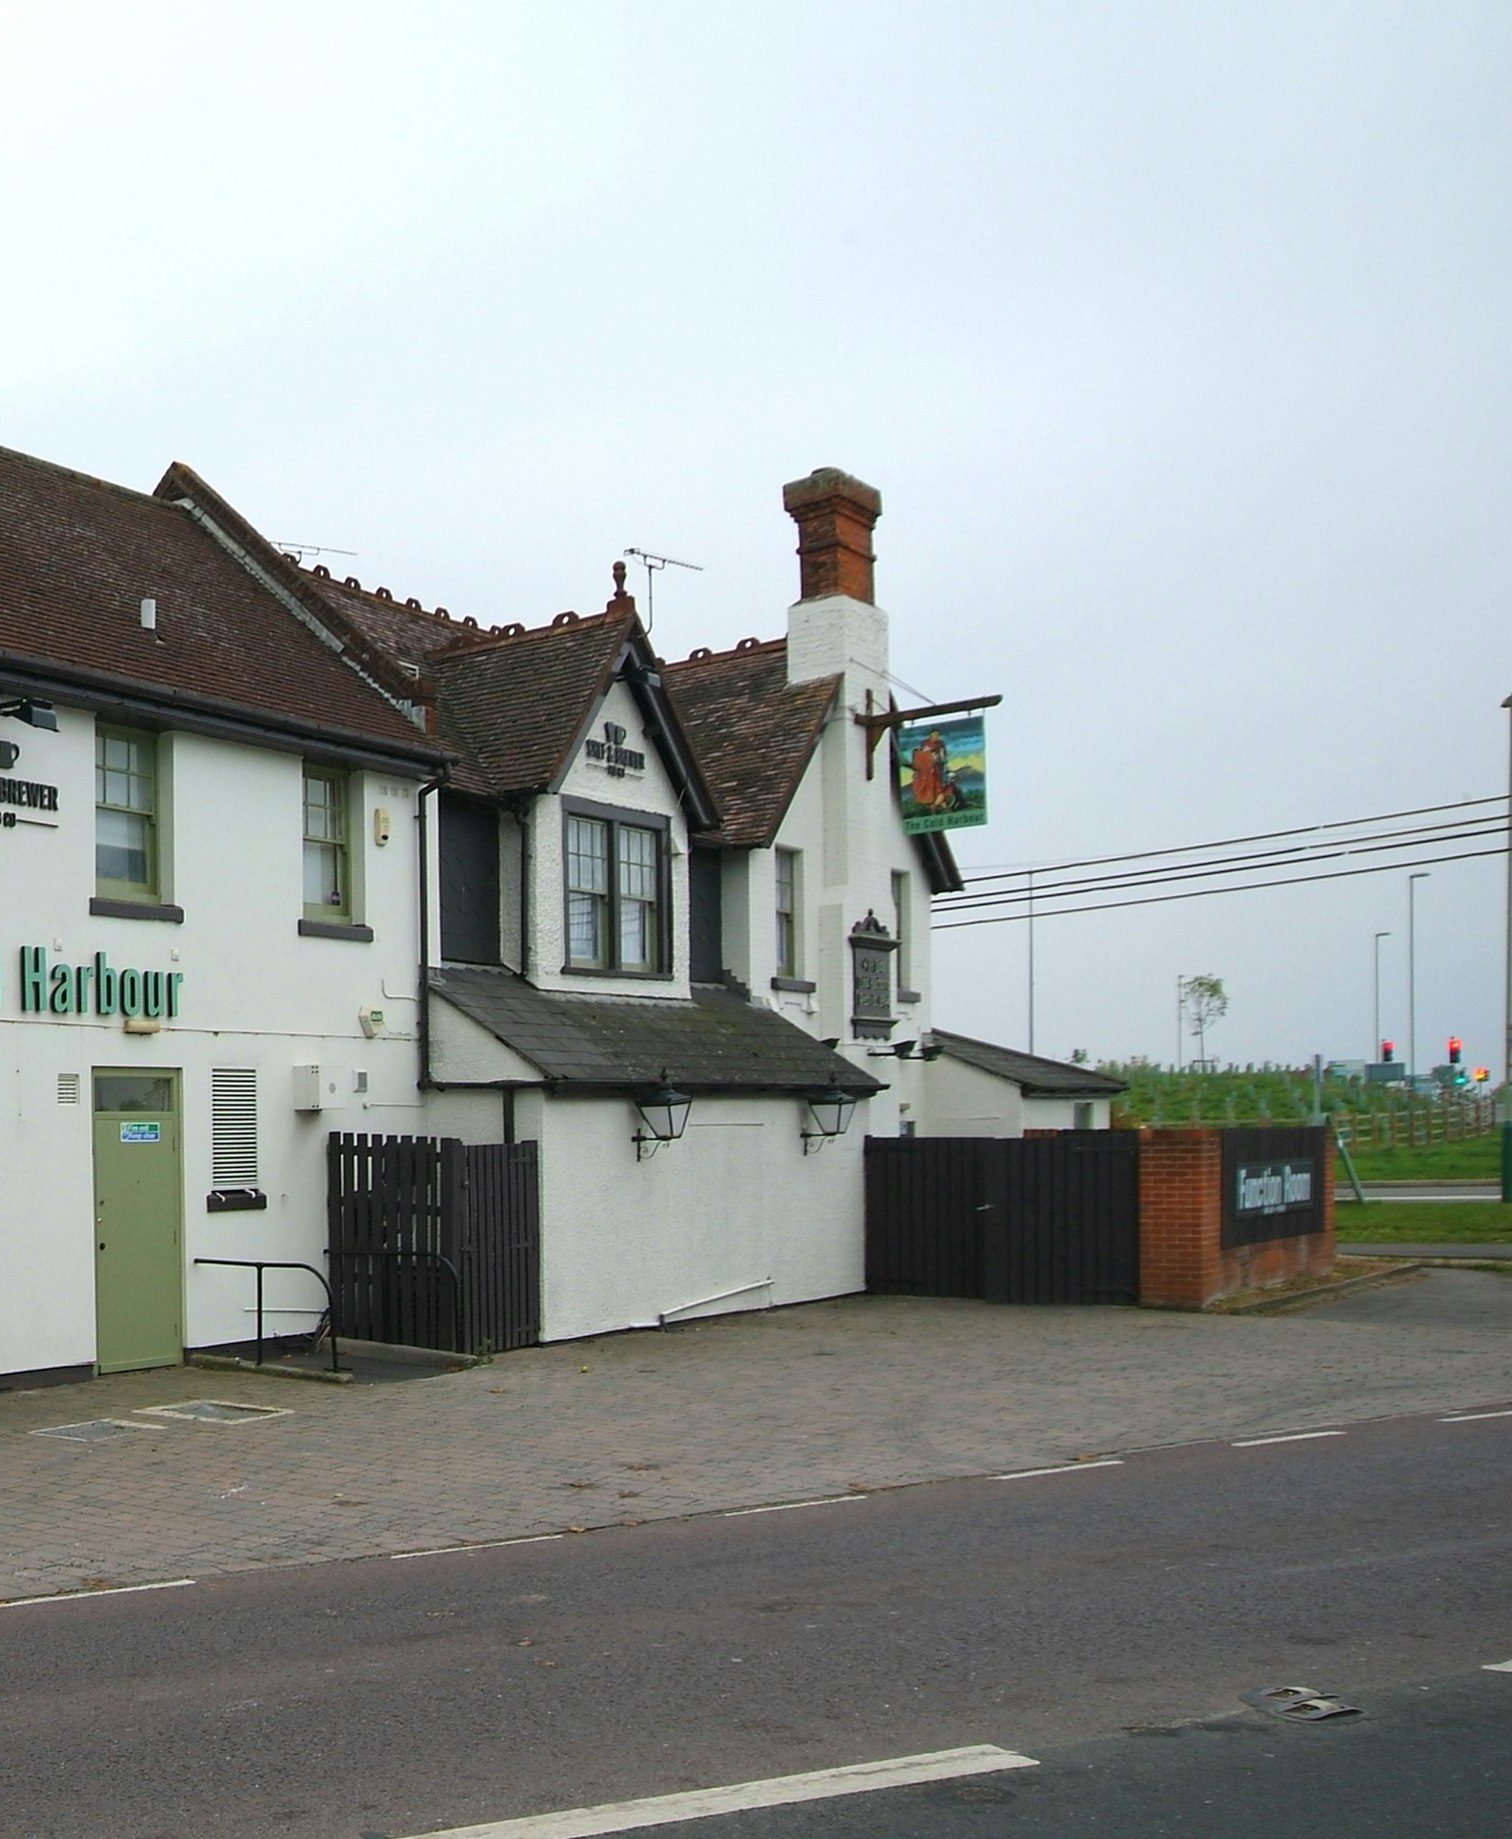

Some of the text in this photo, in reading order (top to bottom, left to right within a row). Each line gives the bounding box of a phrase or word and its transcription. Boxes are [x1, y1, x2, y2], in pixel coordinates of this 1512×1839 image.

[3, 812, 16, 827] CO
[905, 812, 984, 832] The Cold Harbour
[20, 944, 184, 1018] Harbour
[1239, 1165, 1311, 1210] Function Room
